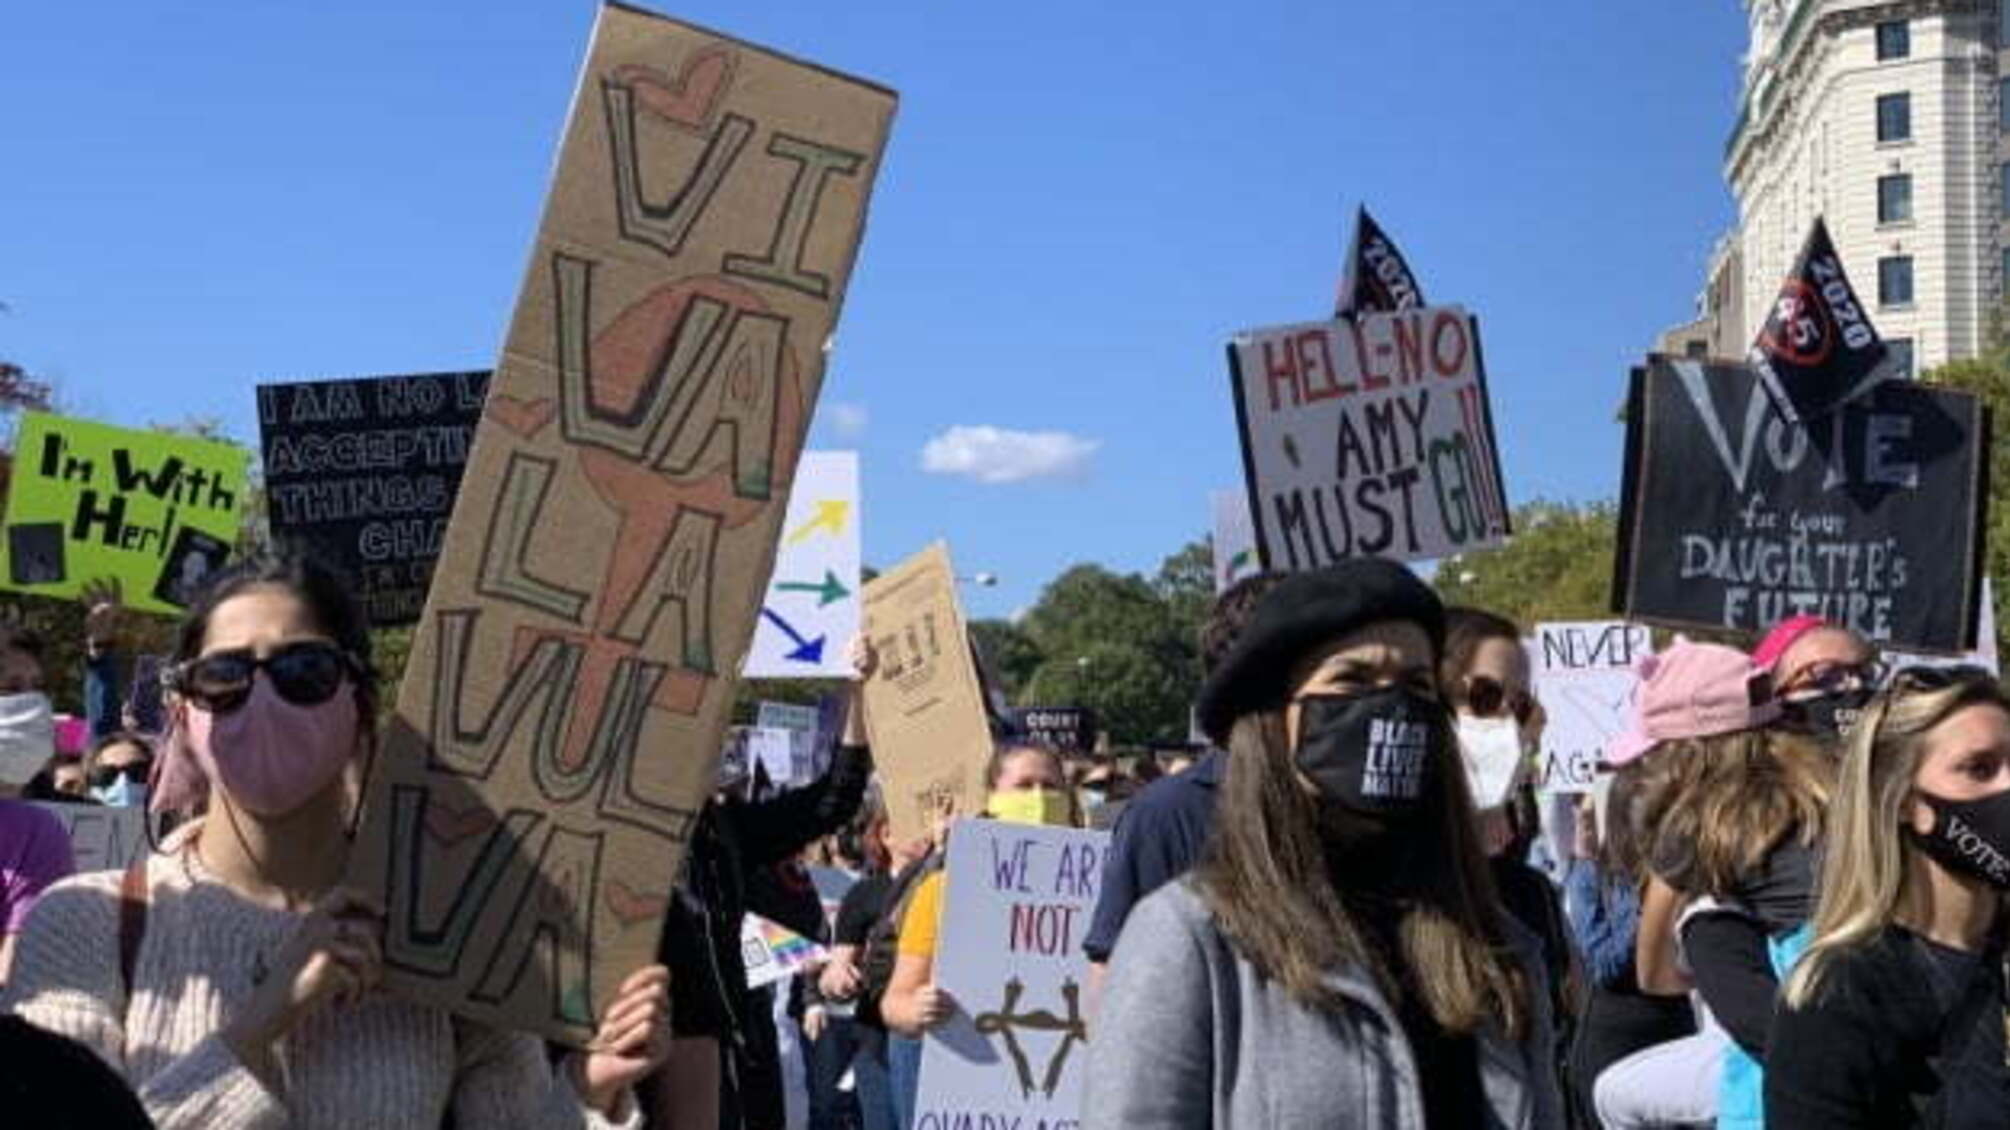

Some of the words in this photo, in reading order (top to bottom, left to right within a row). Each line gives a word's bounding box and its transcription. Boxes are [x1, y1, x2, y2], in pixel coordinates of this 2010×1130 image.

[601, 80, 867, 299] VI
[1810, 256, 1872, 349] 2020
[262, 384, 277, 424] I
[291, 381, 364, 421] AM
[376, 375, 446, 418] NO
[552, 252, 791, 499] VA
[40, 433, 95, 484] I'm
[112, 448, 236, 512] With
[1337, 388, 1430, 479] AMY
[71, 490, 176, 560] Her!
[476, 449, 725, 678] LA
[1273, 467, 1421, 569] MUST
[1543, 625, 1645, 669] NEVER
[1722, 586, 1893, 641] FUTURE
[426, 609, 698, 842] VUL
[382, 782, 605, 1026] VA
[991, 837, 1033, 892] WE
[1055, 841, 1108, 898] AR
[1010, 904, 1081, 958] NOT
